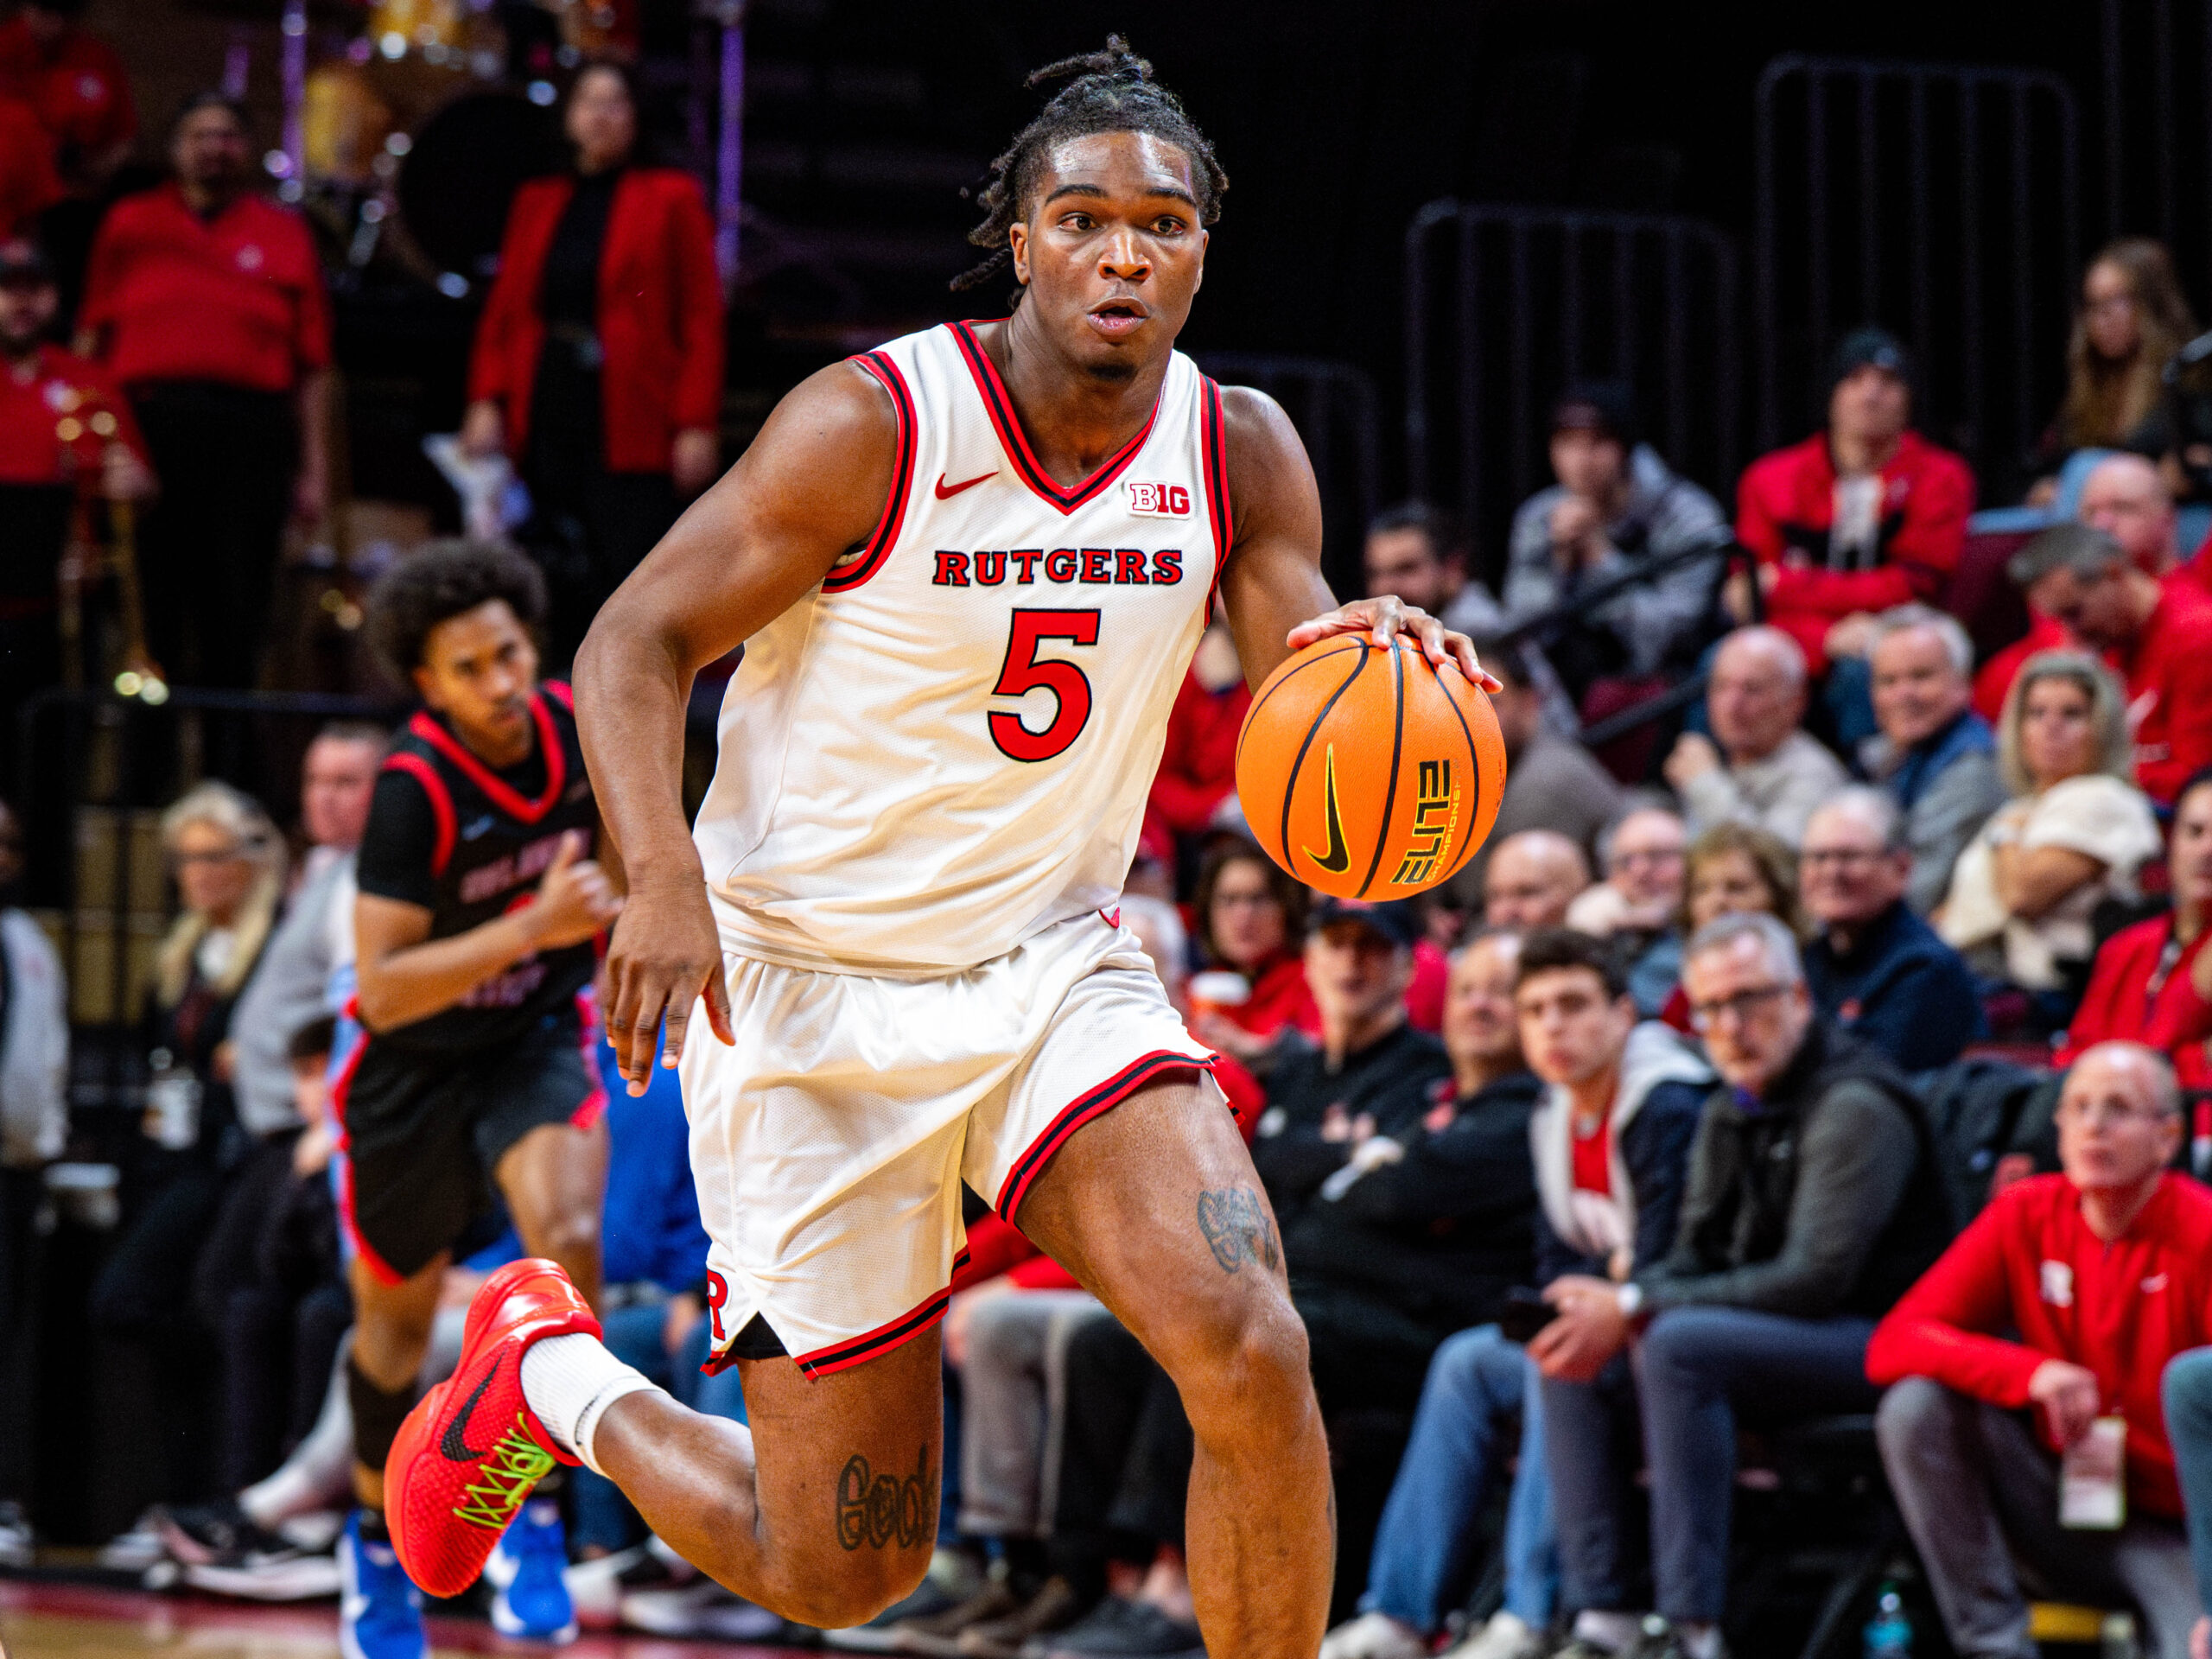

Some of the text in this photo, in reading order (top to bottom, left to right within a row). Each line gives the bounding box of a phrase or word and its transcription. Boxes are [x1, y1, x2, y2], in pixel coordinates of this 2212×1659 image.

[932, 549, 1183, 587] RUTGERS
[988, 607, 1101, 763] 5
[1389, 760, 1450, 884] ELITE
[1427, 758, 1460, 882] CHAMPIONSHP
